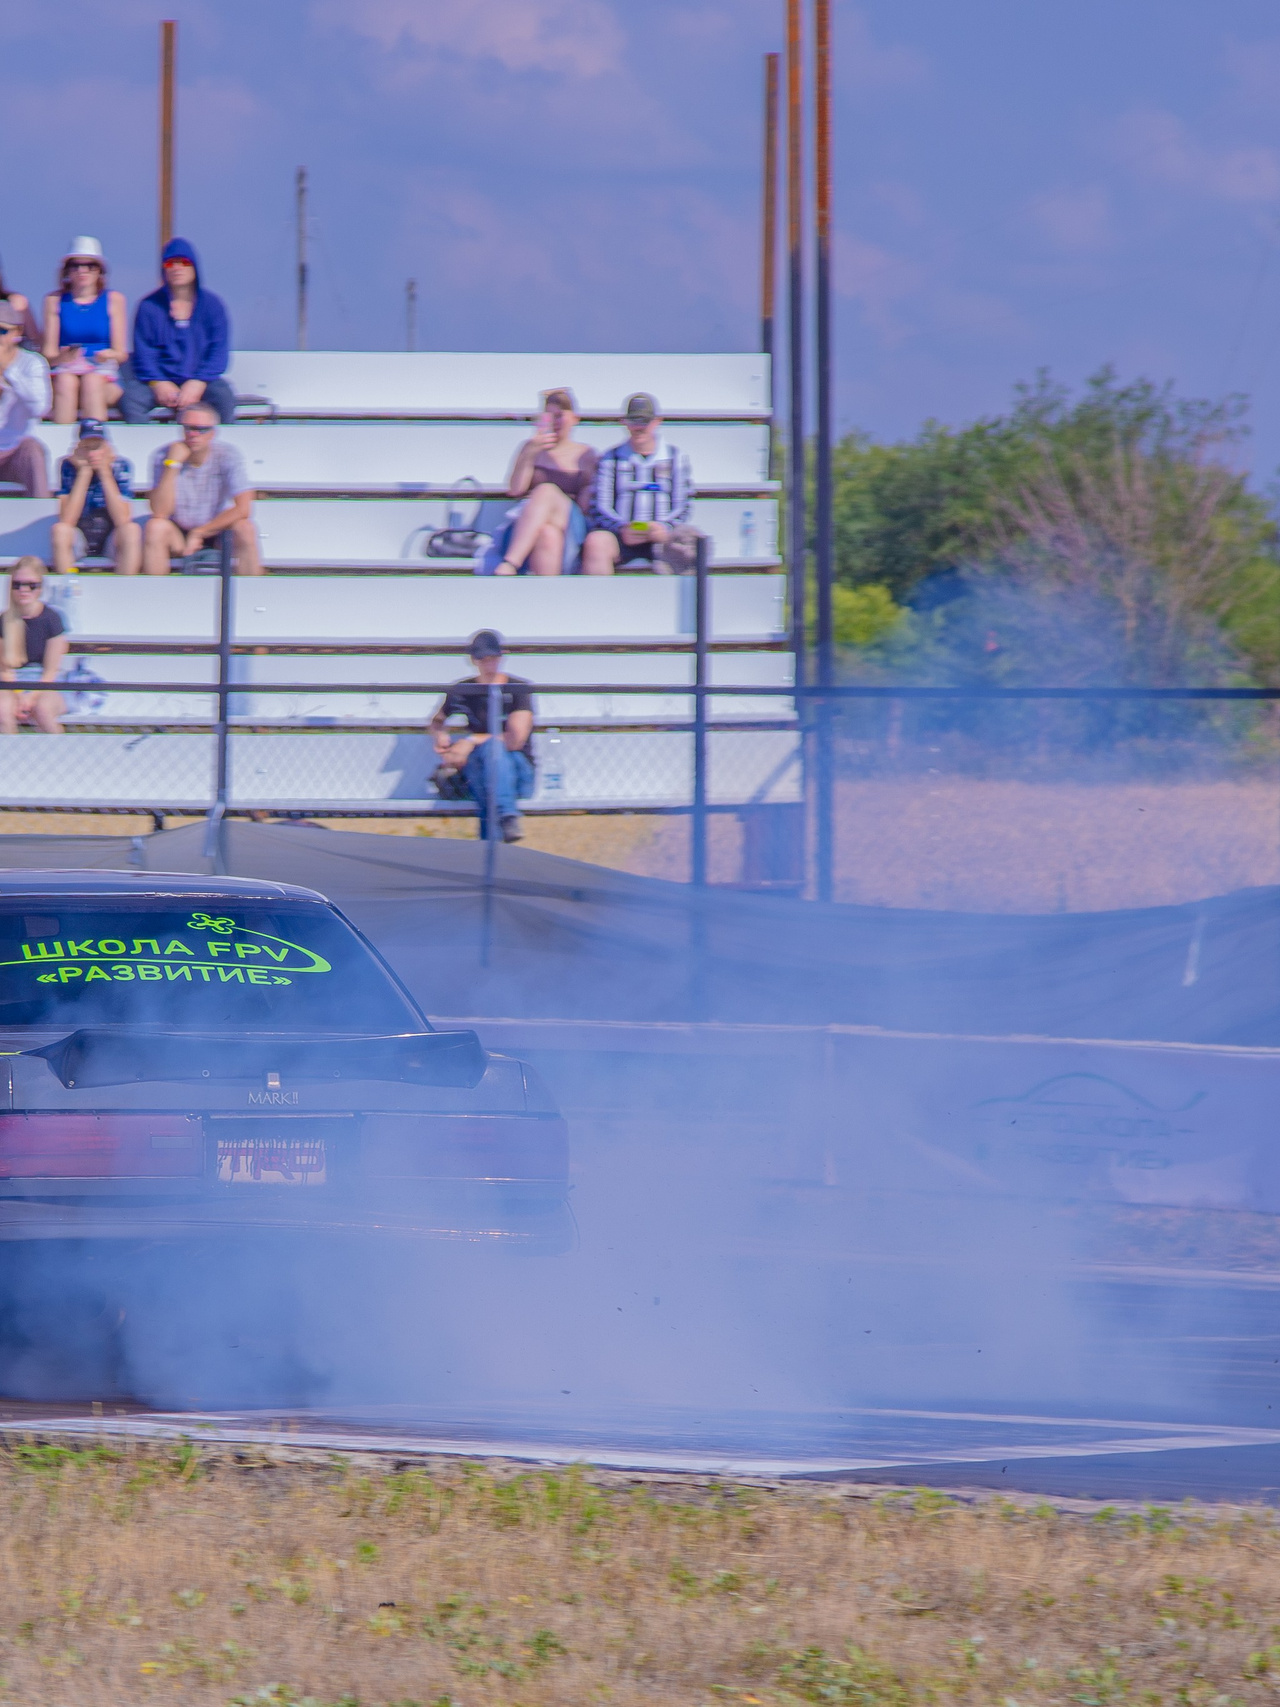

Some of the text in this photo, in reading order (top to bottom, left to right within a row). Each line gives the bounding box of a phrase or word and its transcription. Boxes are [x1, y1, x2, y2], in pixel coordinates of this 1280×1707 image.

[21, 939, 289, 962] ШКОЛА FPV
[36, 964, 293, 986] «РАЗВИТИЕ»
[247, 1091, 290, 1105] MARK
